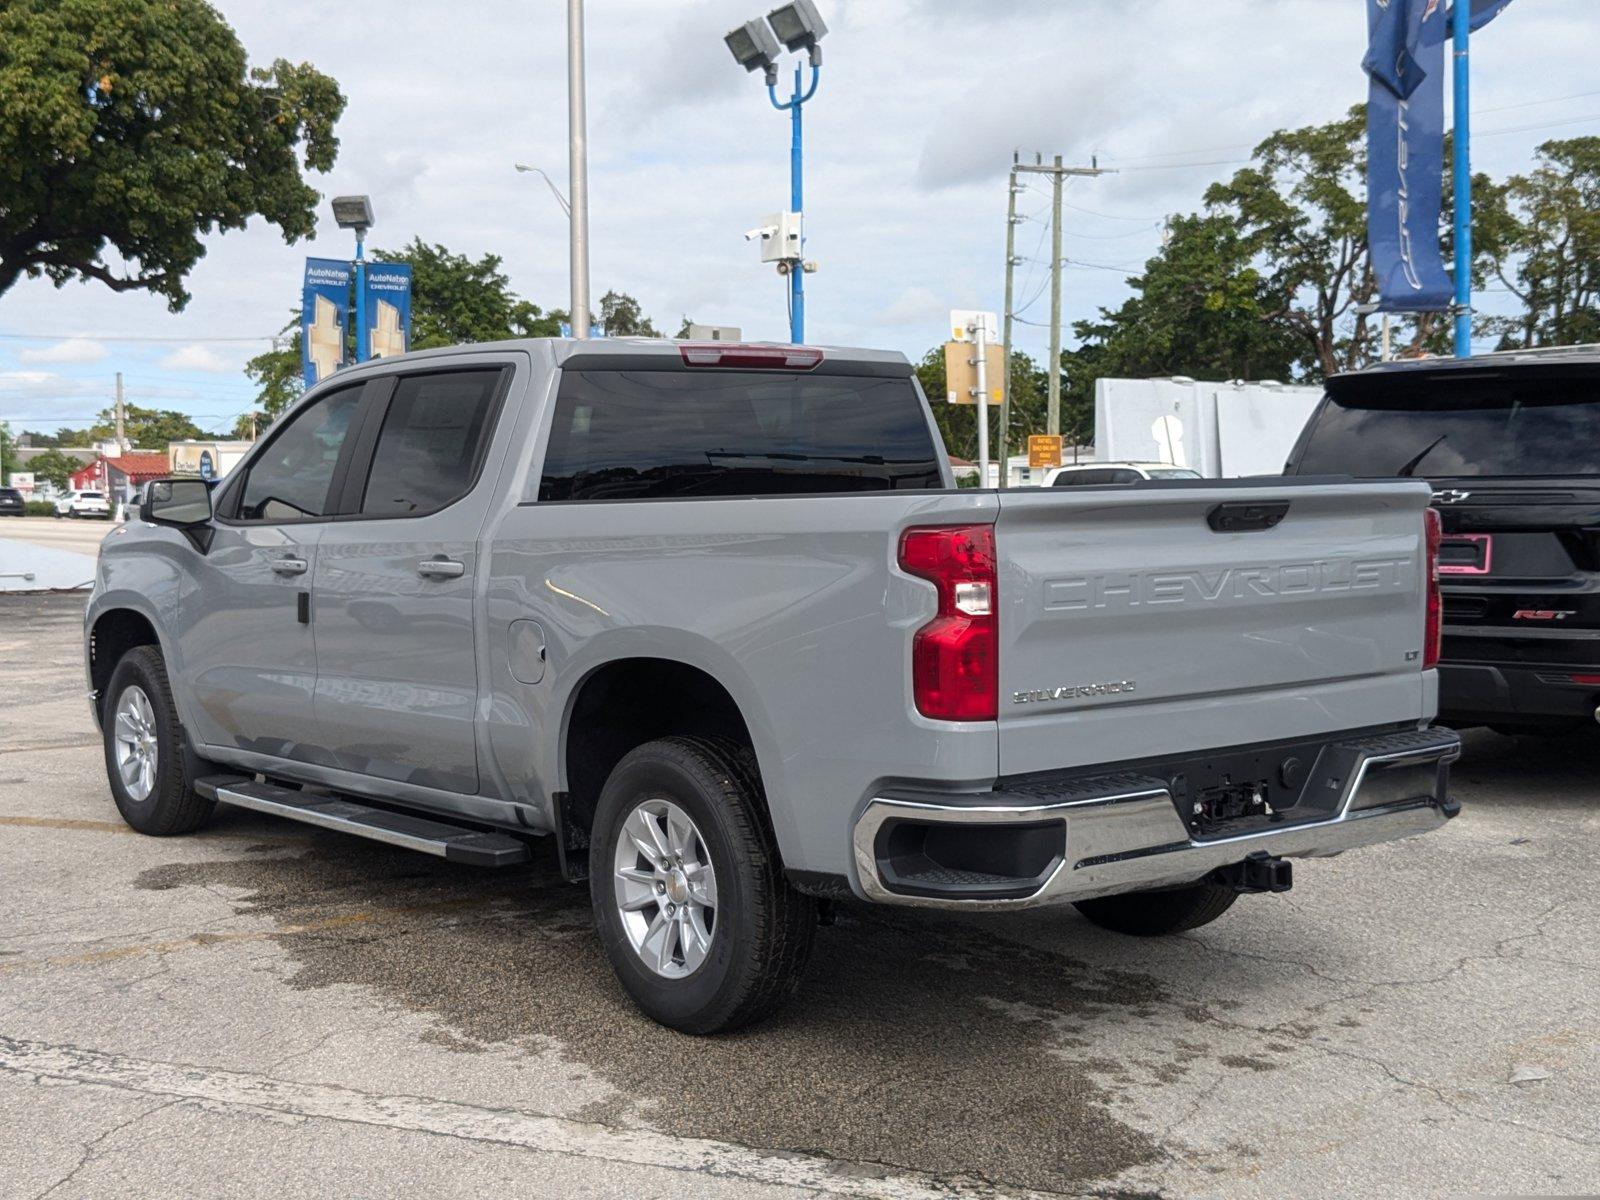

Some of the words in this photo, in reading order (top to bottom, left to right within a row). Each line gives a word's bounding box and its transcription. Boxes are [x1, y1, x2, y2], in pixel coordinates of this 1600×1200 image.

[307, 268, 349, 279] AutoNation
[369, 273, 409, 284] AutoNation
[309, 278, 347, 287] CHEVROLET
[370, 283, 407, 291] CHEVROLET
[1041, 555, 1411, 611] CHEVROLET
[1512, 609, 1578, 620] RST
[1404, 650, 1420, 661] LT
[1013, 680, 1136, 704] SILVERADO
